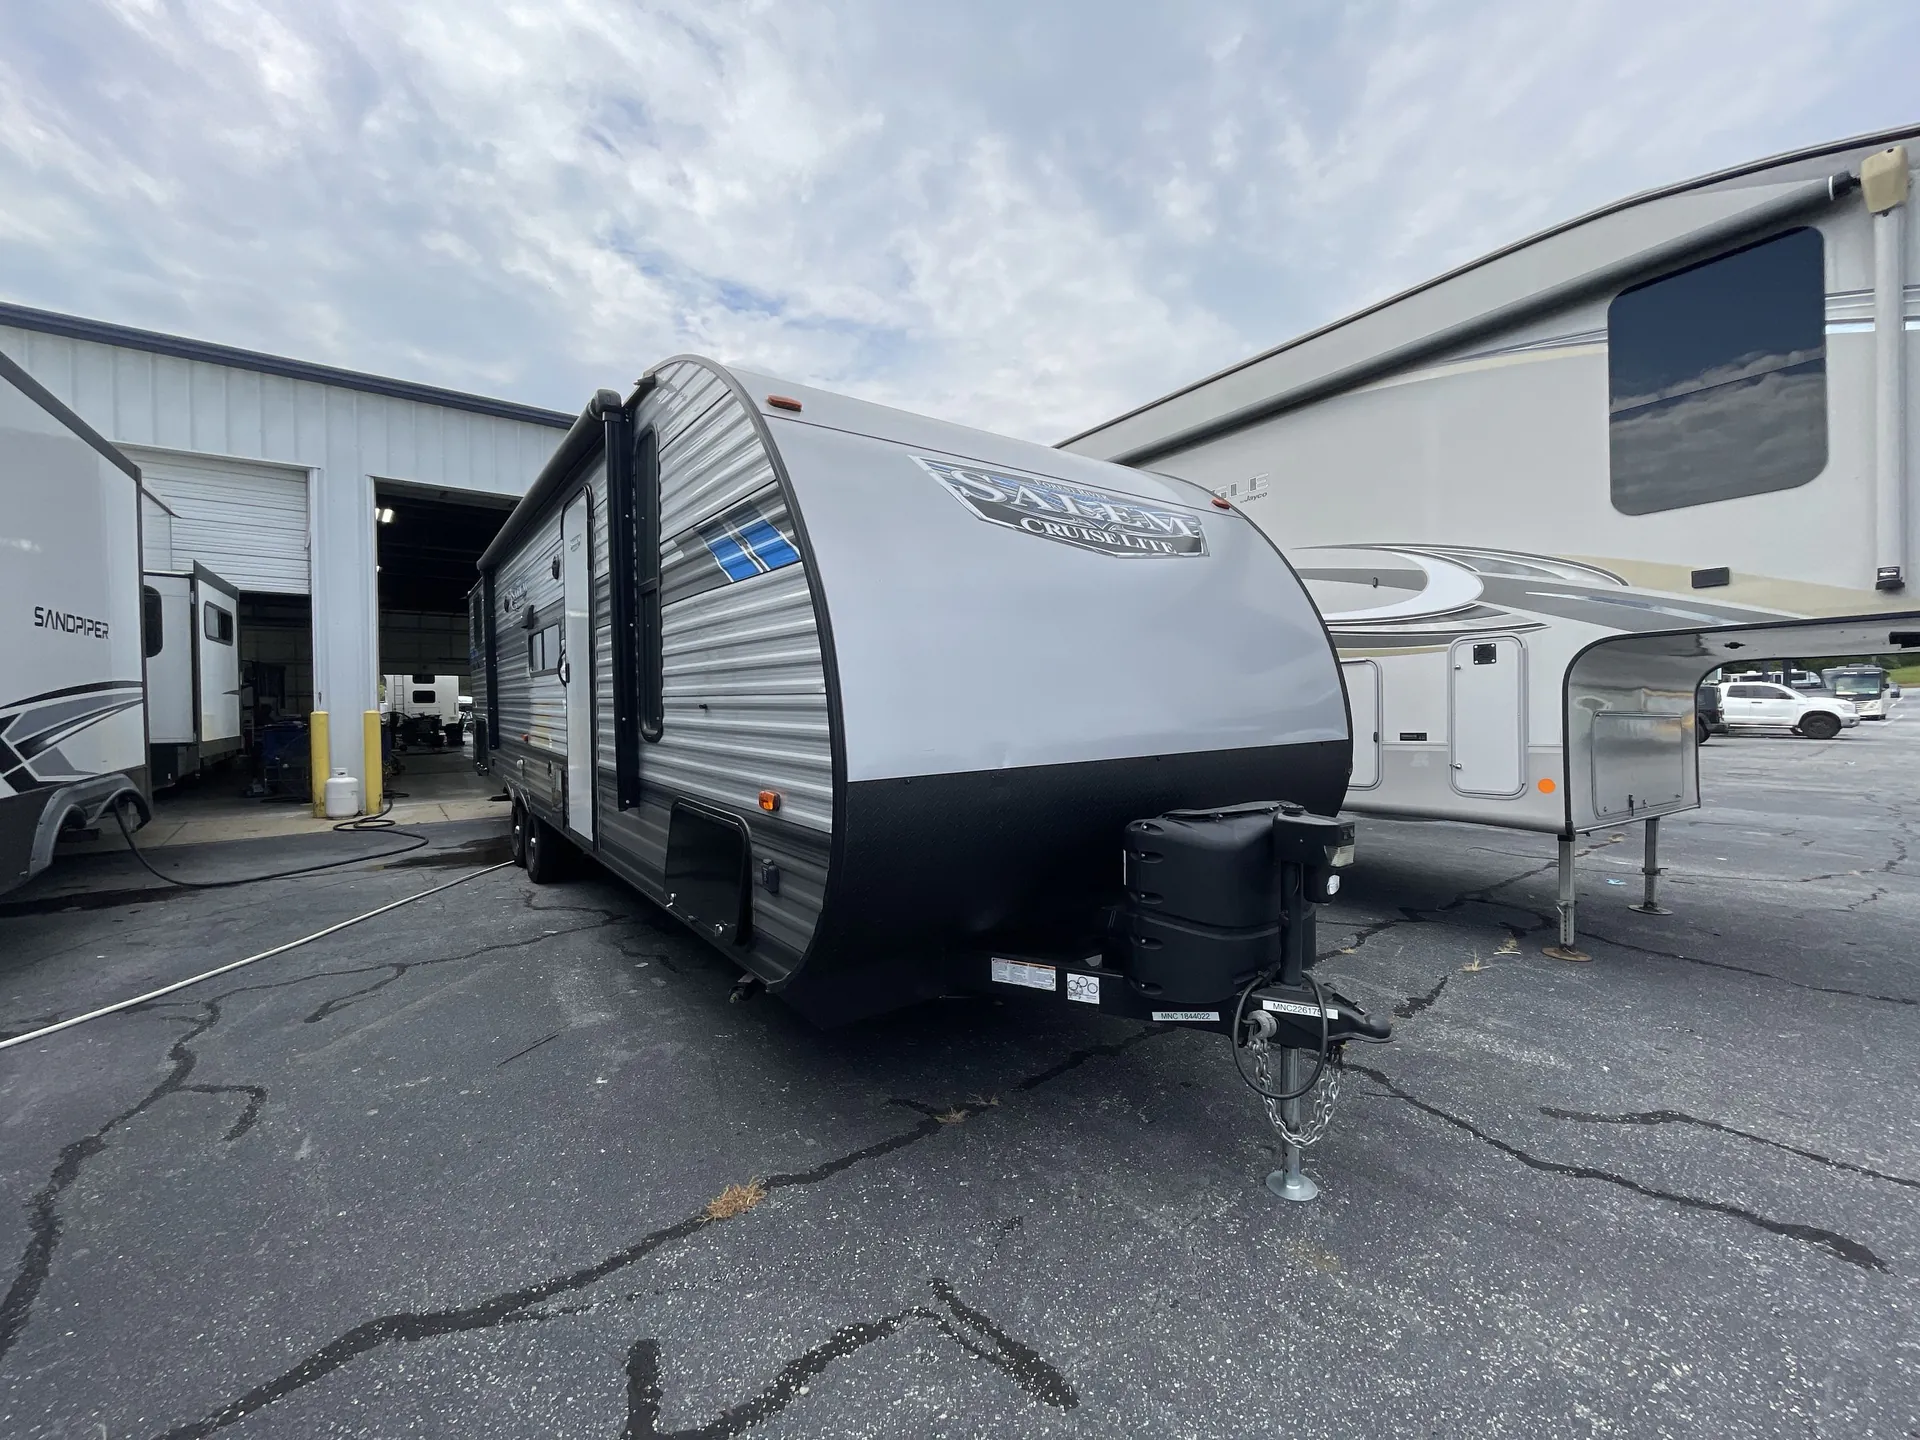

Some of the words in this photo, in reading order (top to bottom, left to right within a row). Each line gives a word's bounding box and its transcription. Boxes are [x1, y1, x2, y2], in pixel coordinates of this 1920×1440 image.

[950, 469, 1200, 538] SALEM
[1246, 492, 1268, 503] Jayco
[34, 605, 109, 640] SANDPIPER
[1160, 1012, 1179, 1020] MNC
